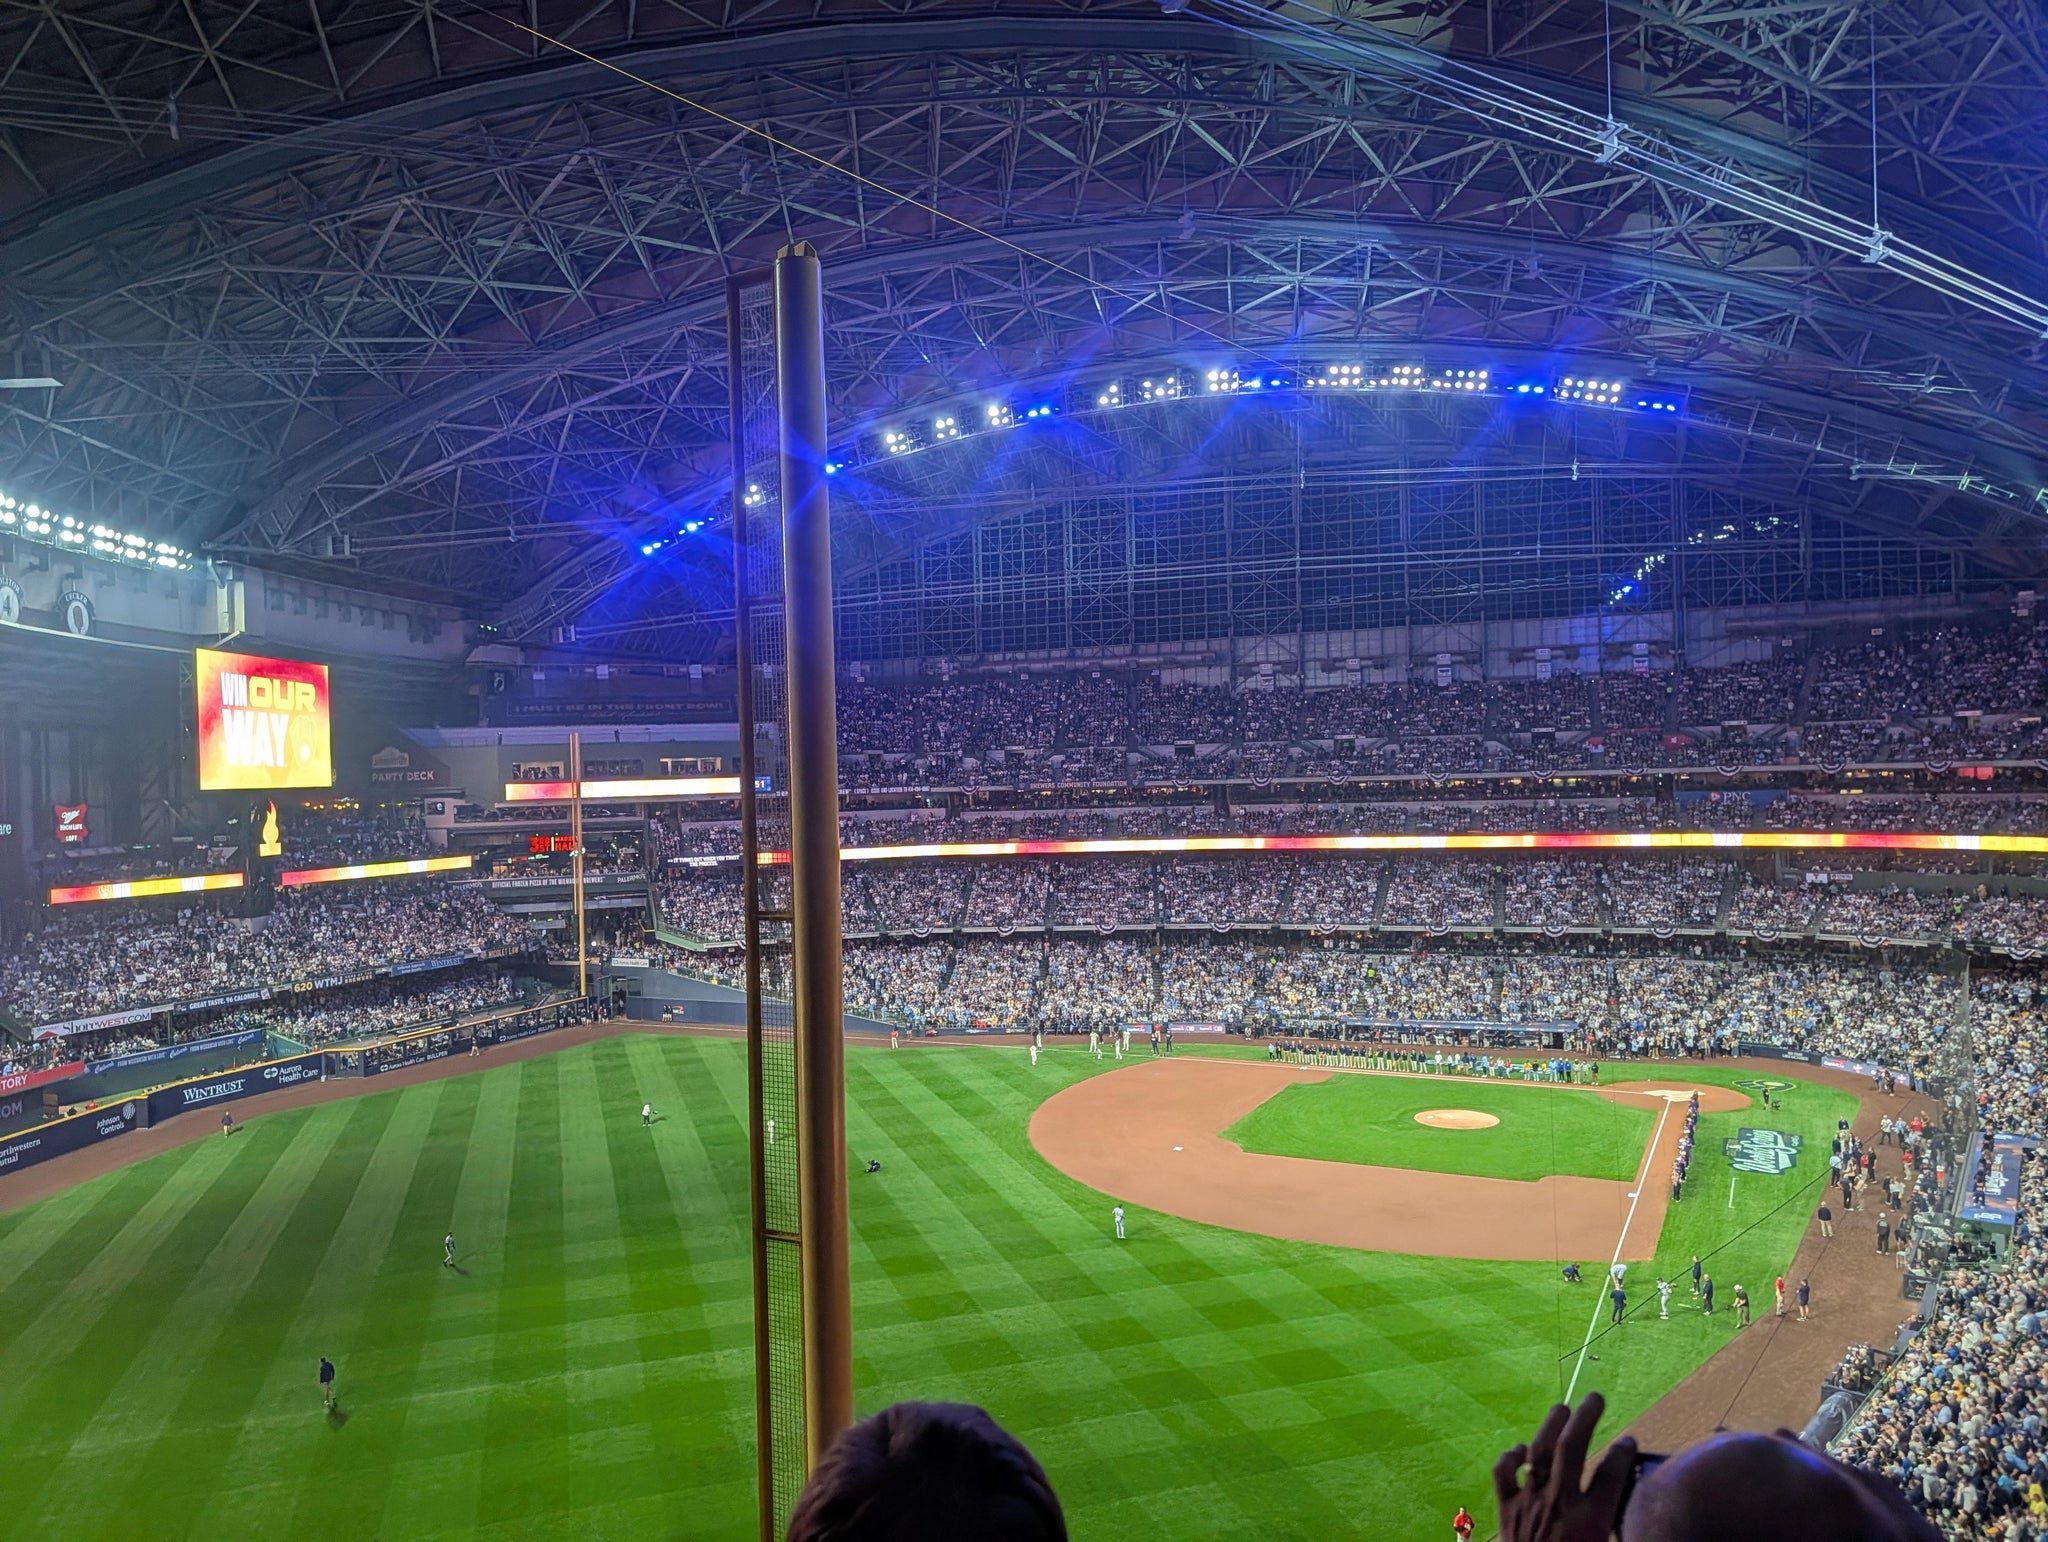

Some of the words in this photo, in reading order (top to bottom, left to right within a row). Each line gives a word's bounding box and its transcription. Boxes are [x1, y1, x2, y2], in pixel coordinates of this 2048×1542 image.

[221, 671, 247, 707] WIN
[249, 676, 316, 712] OUR
[222, 708, 289, 767] WAY
[372, 772, 404, 782] PARTY
[407, 771, 434, 781] DECK
[1723, 791, 1751, 801] PNC
[492, 881, 511, 889] OFFICIAL
[512, 880, 529, 888] FROZEN
[431, 957, 461, 967] WINTRUST
[294, 981, 313, 993] 620
[314, 976, 343, 989] WTMJ
[345, 975, 373, 984] BREWERS
[189, 1001, 207, 1010] GREAT
[208, 998, 225, 1007] TASTE.
[234, 992, 260, 1002] CALORIES.
[427, 1050, 448, 1060] BULLPEN
[279, 1065, 302, 1076] Aurora
[279, 1072, 301, 1084] Health
[302, 1068, 319, 1079] Care
[1, 1074, 28, 1091] TORY
[183, 1079, 244, 1101] WINTRUST
[0, 1100, 23, 1118] OM
[96, 1115, 120, 1129] Johnson
[101, 1121, 125, 1135] Controls
